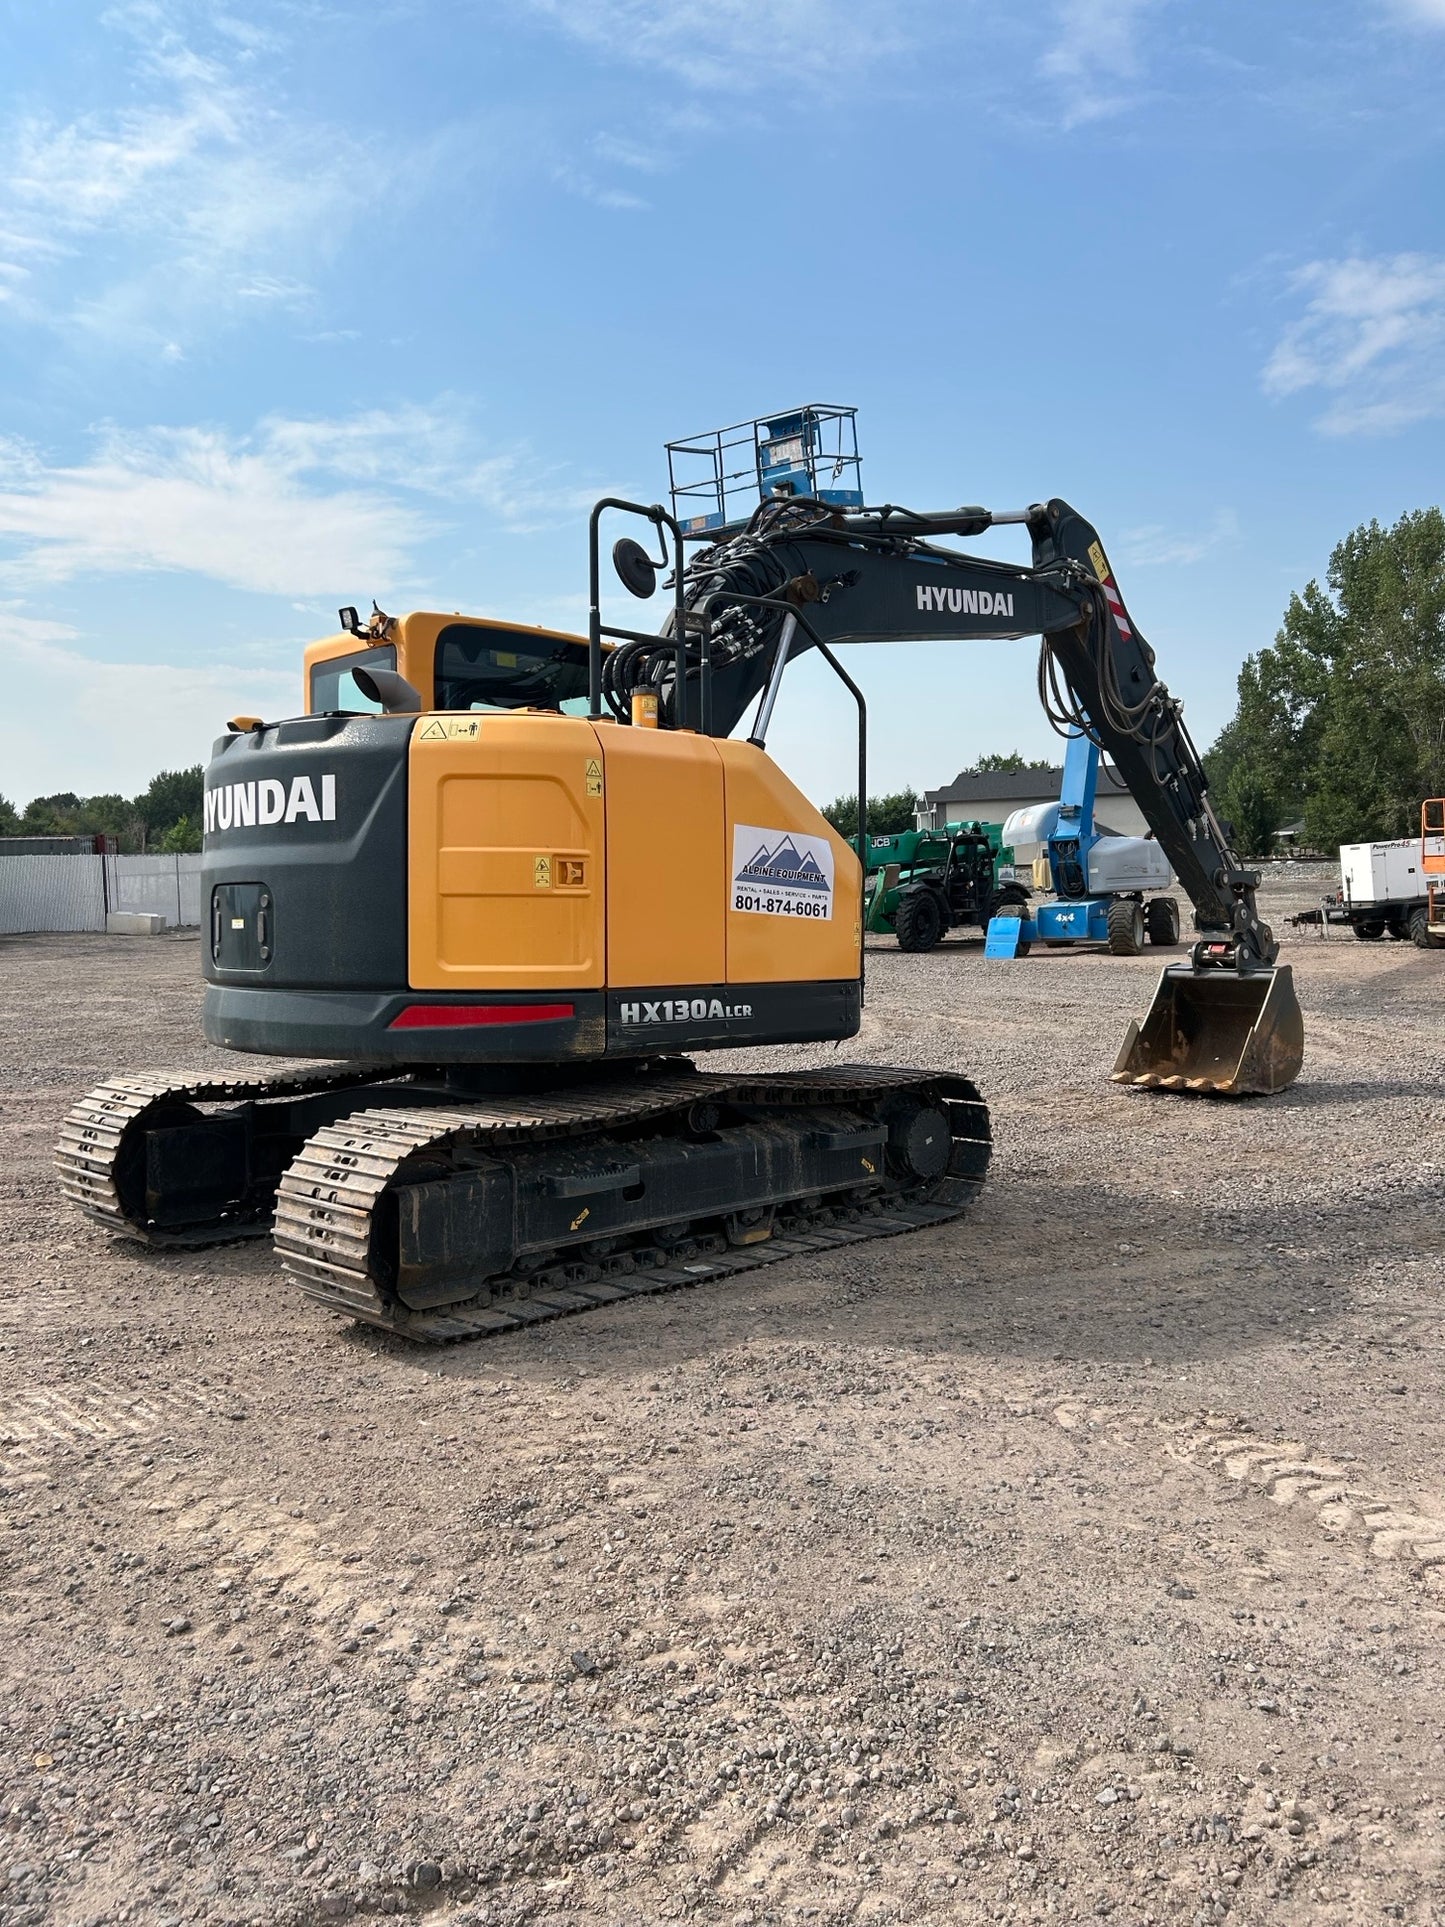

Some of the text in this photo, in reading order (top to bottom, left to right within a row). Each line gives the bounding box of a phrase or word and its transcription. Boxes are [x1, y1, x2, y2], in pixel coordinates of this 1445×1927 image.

[916, 585, 1014, 617] HYUNDAI
[871, 837, 891, 848] JCB
[742, 865, 826, 883] ALPINE EQUIPMENT
[737, 885, 757, 893] RENTAL
[763, 888, 780, 896] SALES
[785, 891, 806, 899] SERVICE
[735, 895, 828, 918] 801-874-6061
[1055, 912, 1075, 922] 4x4
